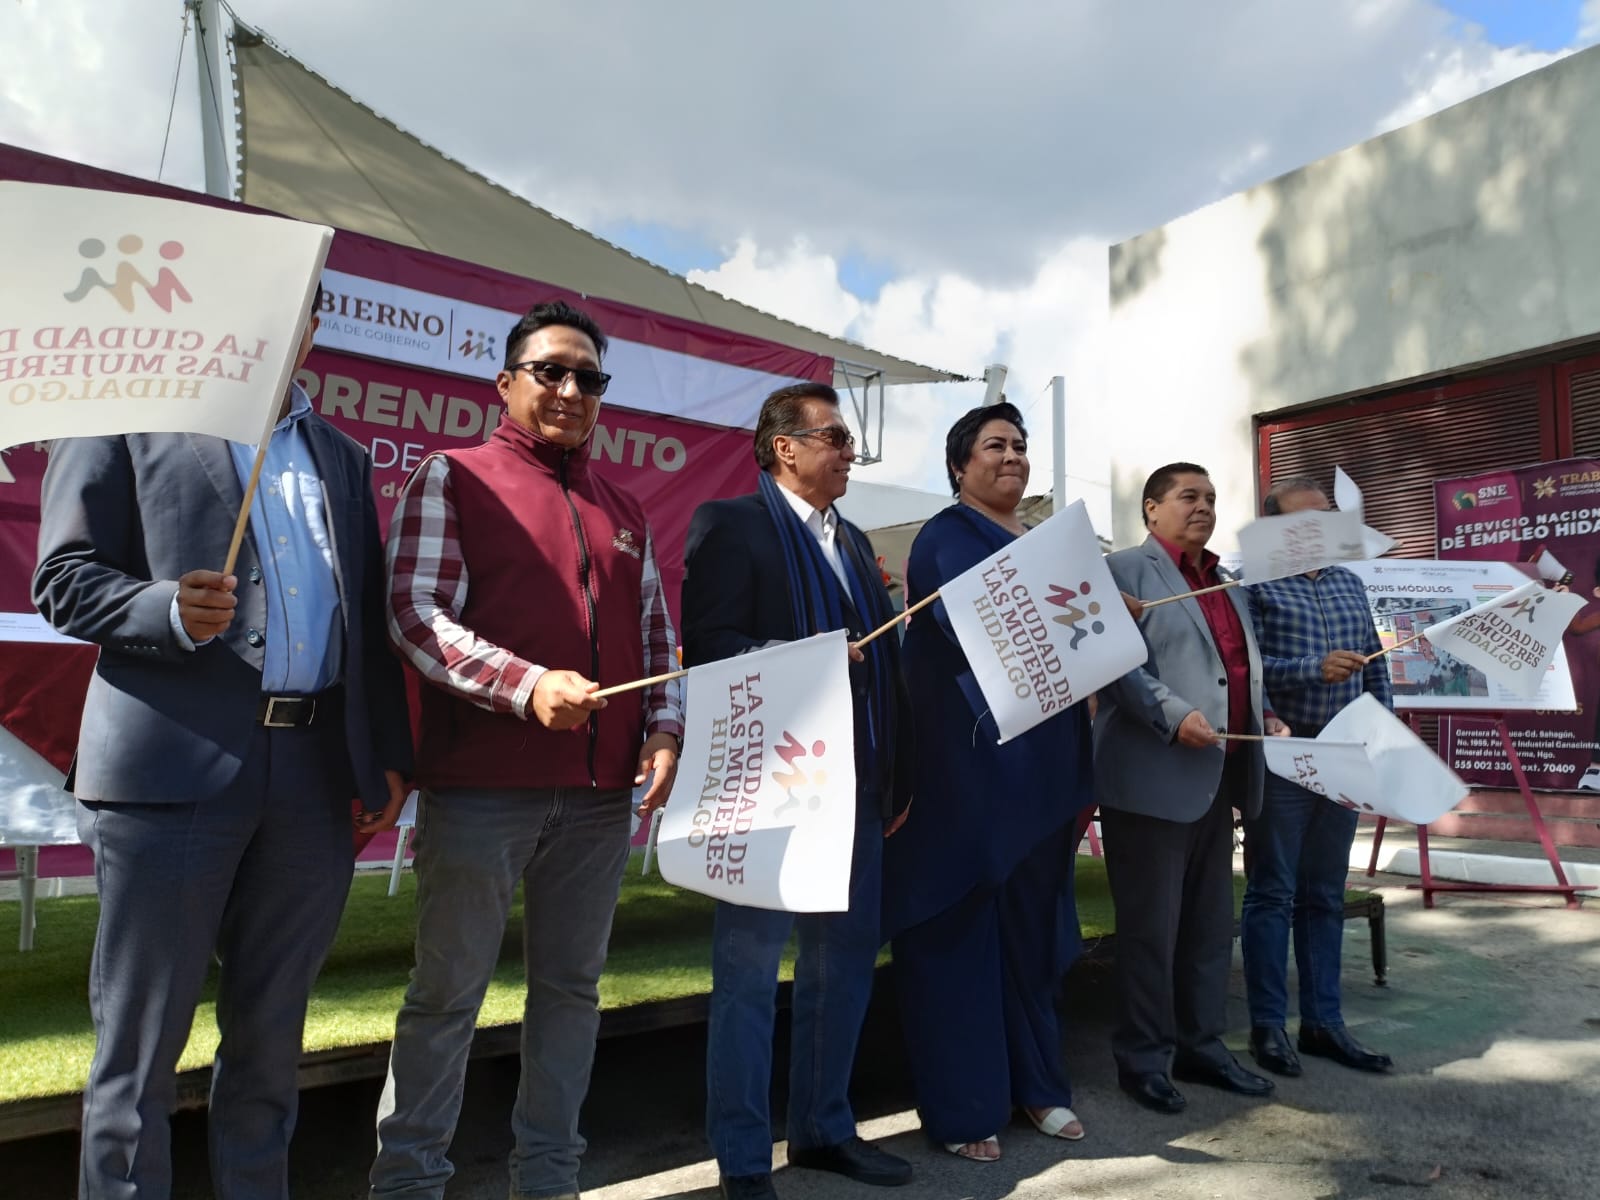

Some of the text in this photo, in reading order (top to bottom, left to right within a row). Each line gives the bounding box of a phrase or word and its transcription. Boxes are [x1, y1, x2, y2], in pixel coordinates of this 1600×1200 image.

[319, 289, 444, 336] BIERNO
[343, 323, 360, 336] DE
[364, 328, 431, 351] GOBIERNO
[371, 437, 425, 473] DE
[1478, 471, 1600, 499] SNE TRAB
[1441, 519, 1600, 551] DE EMPLEO HIDA
[1455, 508, 1600, 536] SERVICIO NACION
[1362, 583, 1454, 593] OQUIS MÓDULOS
[973, 594, 1032, 699] HIDALGO
[981, 567, 1056, 714] LAS MUJERES
[995, 553, 1073, 709] LA CIUDAD DE
[1452, 626, 1522, 671] HIDALGO
[1475, 621, 1540, 668] MUJERES
[1532, 640, 1547, 658] DE
[1456, 729, 1490, 737] Carretera
[1518, 740, 1554, 748] Industrial
[687, 715, 728, 849] HIDALGO
[706, 681, 745, 880] LAS MUJERES
[726, 672, 764, 885] LA CIUDAD DE
[1474, 761, 1492, 770] 002
[1494, 761, 1513, 771] 330
[1543, 763, 1576, 773] 70409
